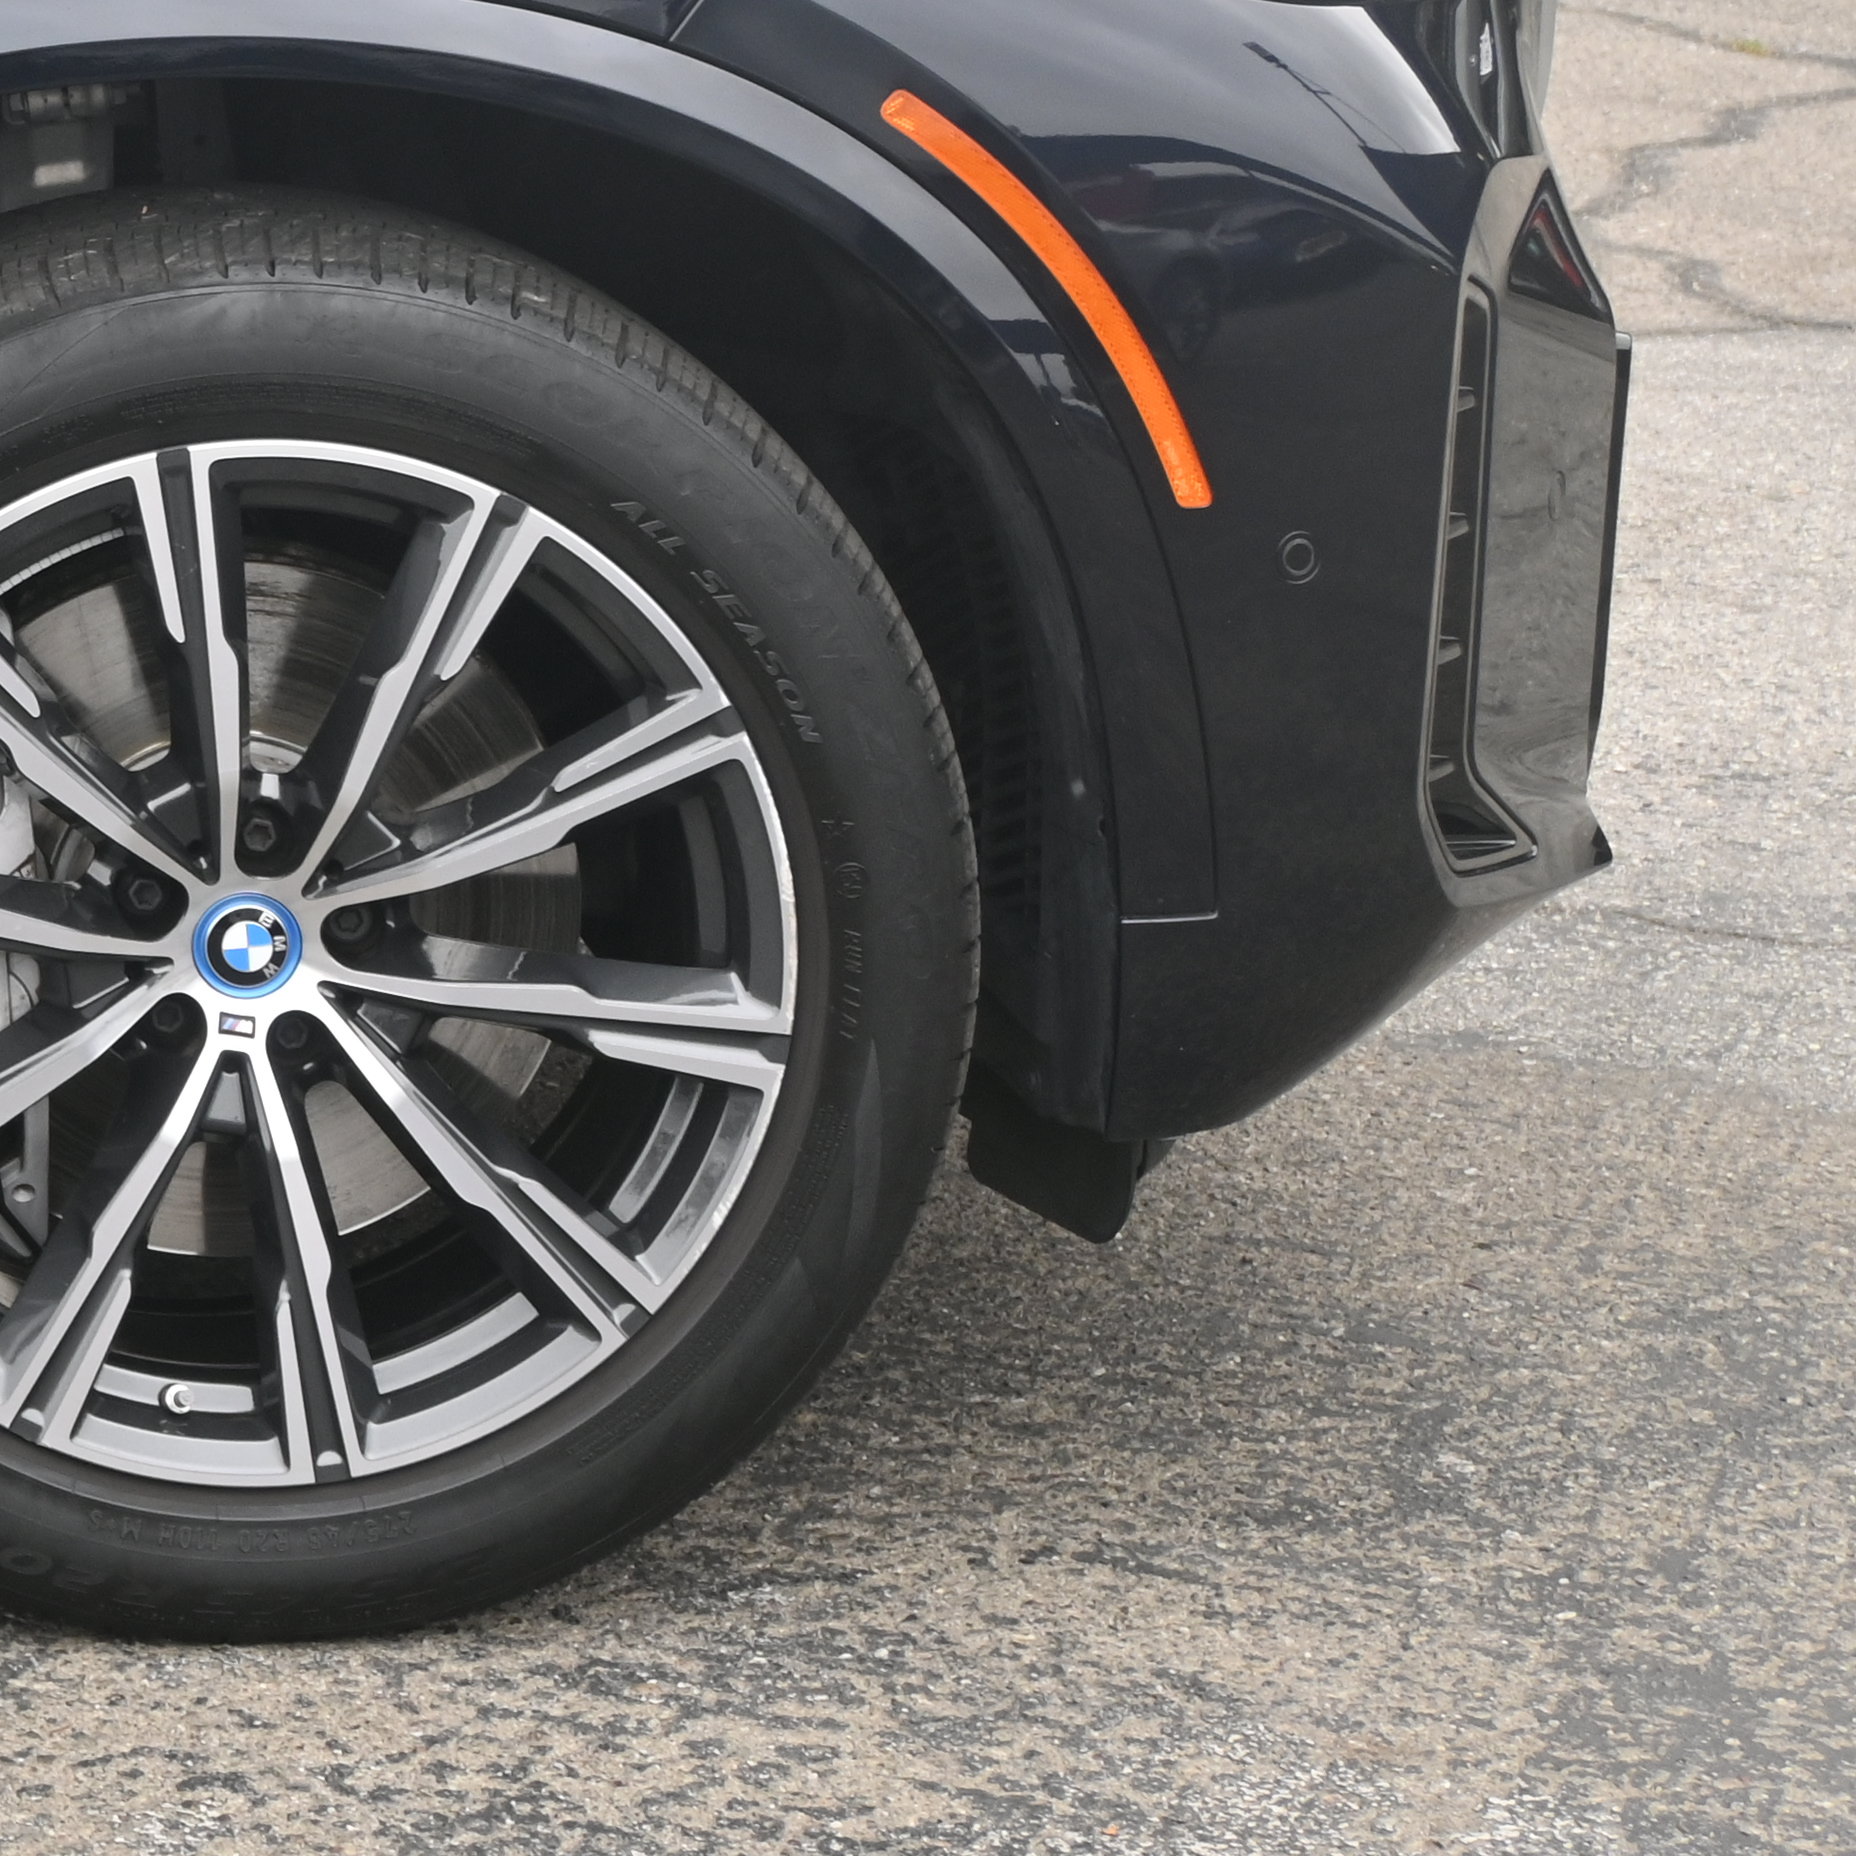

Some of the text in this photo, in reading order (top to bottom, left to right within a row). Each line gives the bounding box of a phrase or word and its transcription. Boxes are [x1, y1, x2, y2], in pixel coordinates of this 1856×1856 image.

[611, 498, 685, 557] ALL
[690, 567, 823, 747] SEASON
[258, 910, 287, 979] BMW
[237, 1525, 290, 1554] R20
